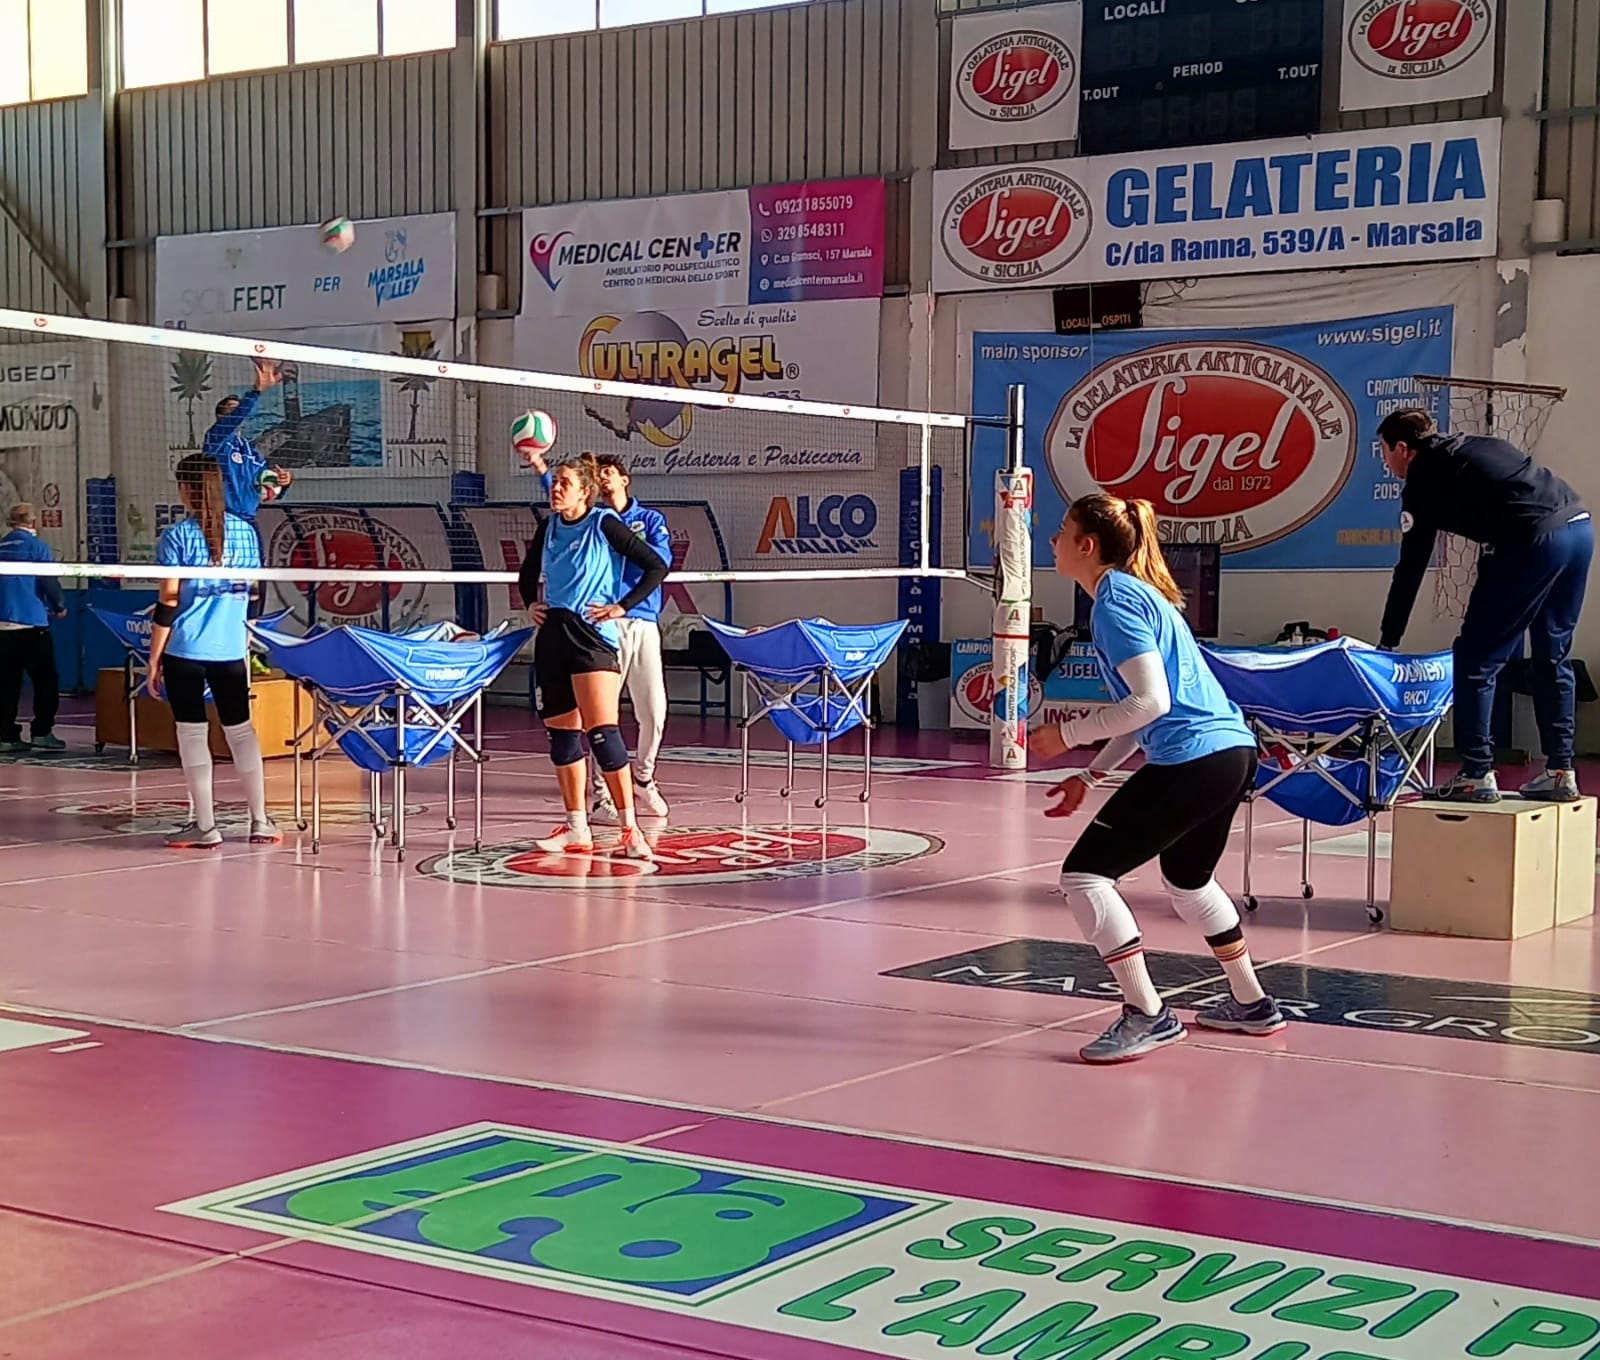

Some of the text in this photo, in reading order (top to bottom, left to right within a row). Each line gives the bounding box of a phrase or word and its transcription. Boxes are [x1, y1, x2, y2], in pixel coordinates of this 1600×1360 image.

[1104, 0, 1166, 21] LOCALI
[1373, 0, 1469, 56] Sigel
[967, 36, 1015, 71] GELATERIA
[1016, 35, 1070, 71] ARTIGIANALE
[976, 46, 1054, 101] Sigel
[1172, 61, 1223, 78] PERIOD
[1277, 63, 1319, 80] T.OUT
[1400, 58, 1446, 75] SICILIA
[1082, 86, 1119, 101] T.OUT
[1000, 102, 1037, 118] SICILIA
[1105, 137, 1487, 228] GELATERIA
[954, 174, 1014, 215] GELATERIA
[1015, 173, 1085, 219] ARTIGIANALE
[966, 189, 1064, 256] Sigel
[558, 239, 644, 267] MEDICAL
[841, 246, 873, 259] Marsala
[1105, 240, 1165, 267] C/da
[1171, 237, 1257, 262] Ranna,
[1262, 226, 1345, 256] 539/A
[1366, 216, 1483, 249] Marsala
[368, 256, 425, 289] MARSALA
[602, 278, 636, 289] CENTRO
[645, 274, 687, 285] MEDICINA
[687, 272, 714, 283] DELLO
[715, 269, 740, 280] SPORT
[993, 259, 1043, 278] SICILIA
[313, 276, 341, 293] PER
[743, 310, 755, 325] di
[1061, 312, 1132, 329] LOCALI OSPITI
[1316, 317, 1443, 347] www.sigel.it
[981, 342, 1089, 363] main sponsor
[1065, 351, 1343, 450] LA GELATERIA ARTIGIANALE
[1095, 376, 1300, 503] Sigel
[630, 455, 658, 472] per
[664, 448, 742, 474] Gelateria
[747, 455, 758, 467] e
[764, 445, 863, 467] Pasticceria
[1212, 475, 1272, 492] dal 1972
[755, 493, 878, 554] ALCO
[1156, 514, 1253, 545] SICILIA
[770, 538, 859, 554] ITALIA
[1058, 662, 1101, 680] SIGEL
[905, 1215, 1460, 1340] SERVIZI
